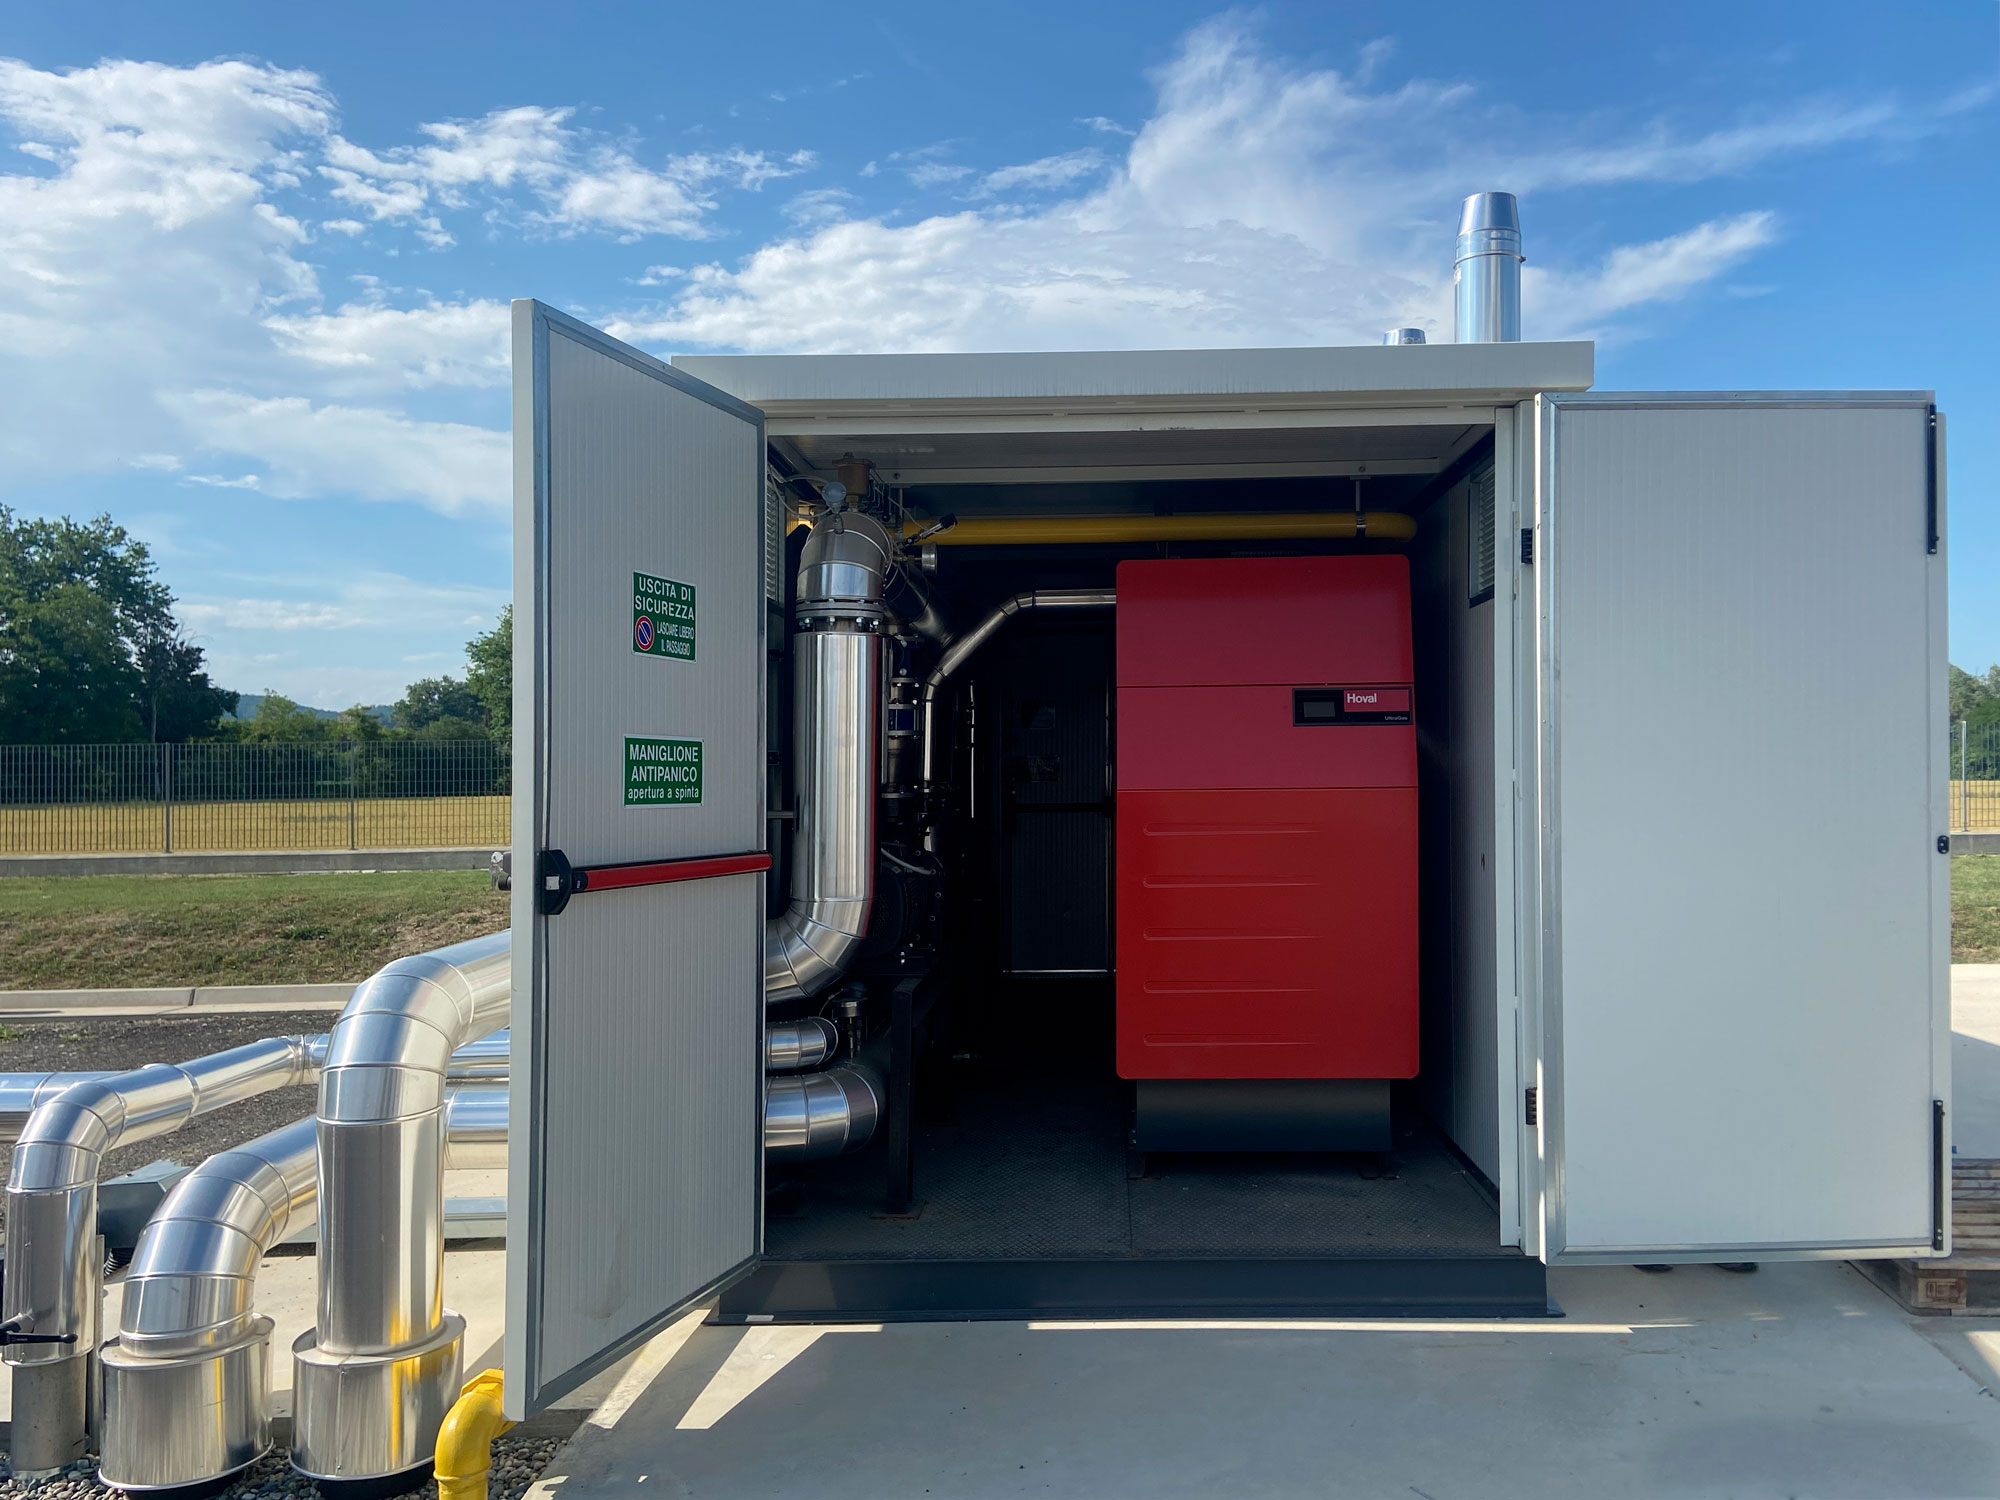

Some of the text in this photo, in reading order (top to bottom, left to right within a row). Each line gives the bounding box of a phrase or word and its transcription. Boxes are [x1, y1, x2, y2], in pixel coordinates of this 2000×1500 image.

[639, 577, 691, 601] USCITA DI
[635, 595, 695, 620] SICUREZZA
[656, 621, 694, 640] LASCIARE LIBERO
[661, 639, 691, 656] IL PASSAGGIO
[1346, 693, 1377, 703] Hoval
[629, 744, 699, 762] MANIGLIONE
[631, 766, 698, 782] ANTIPANICO
[628, 785, 699, 802] apertura a spinta
